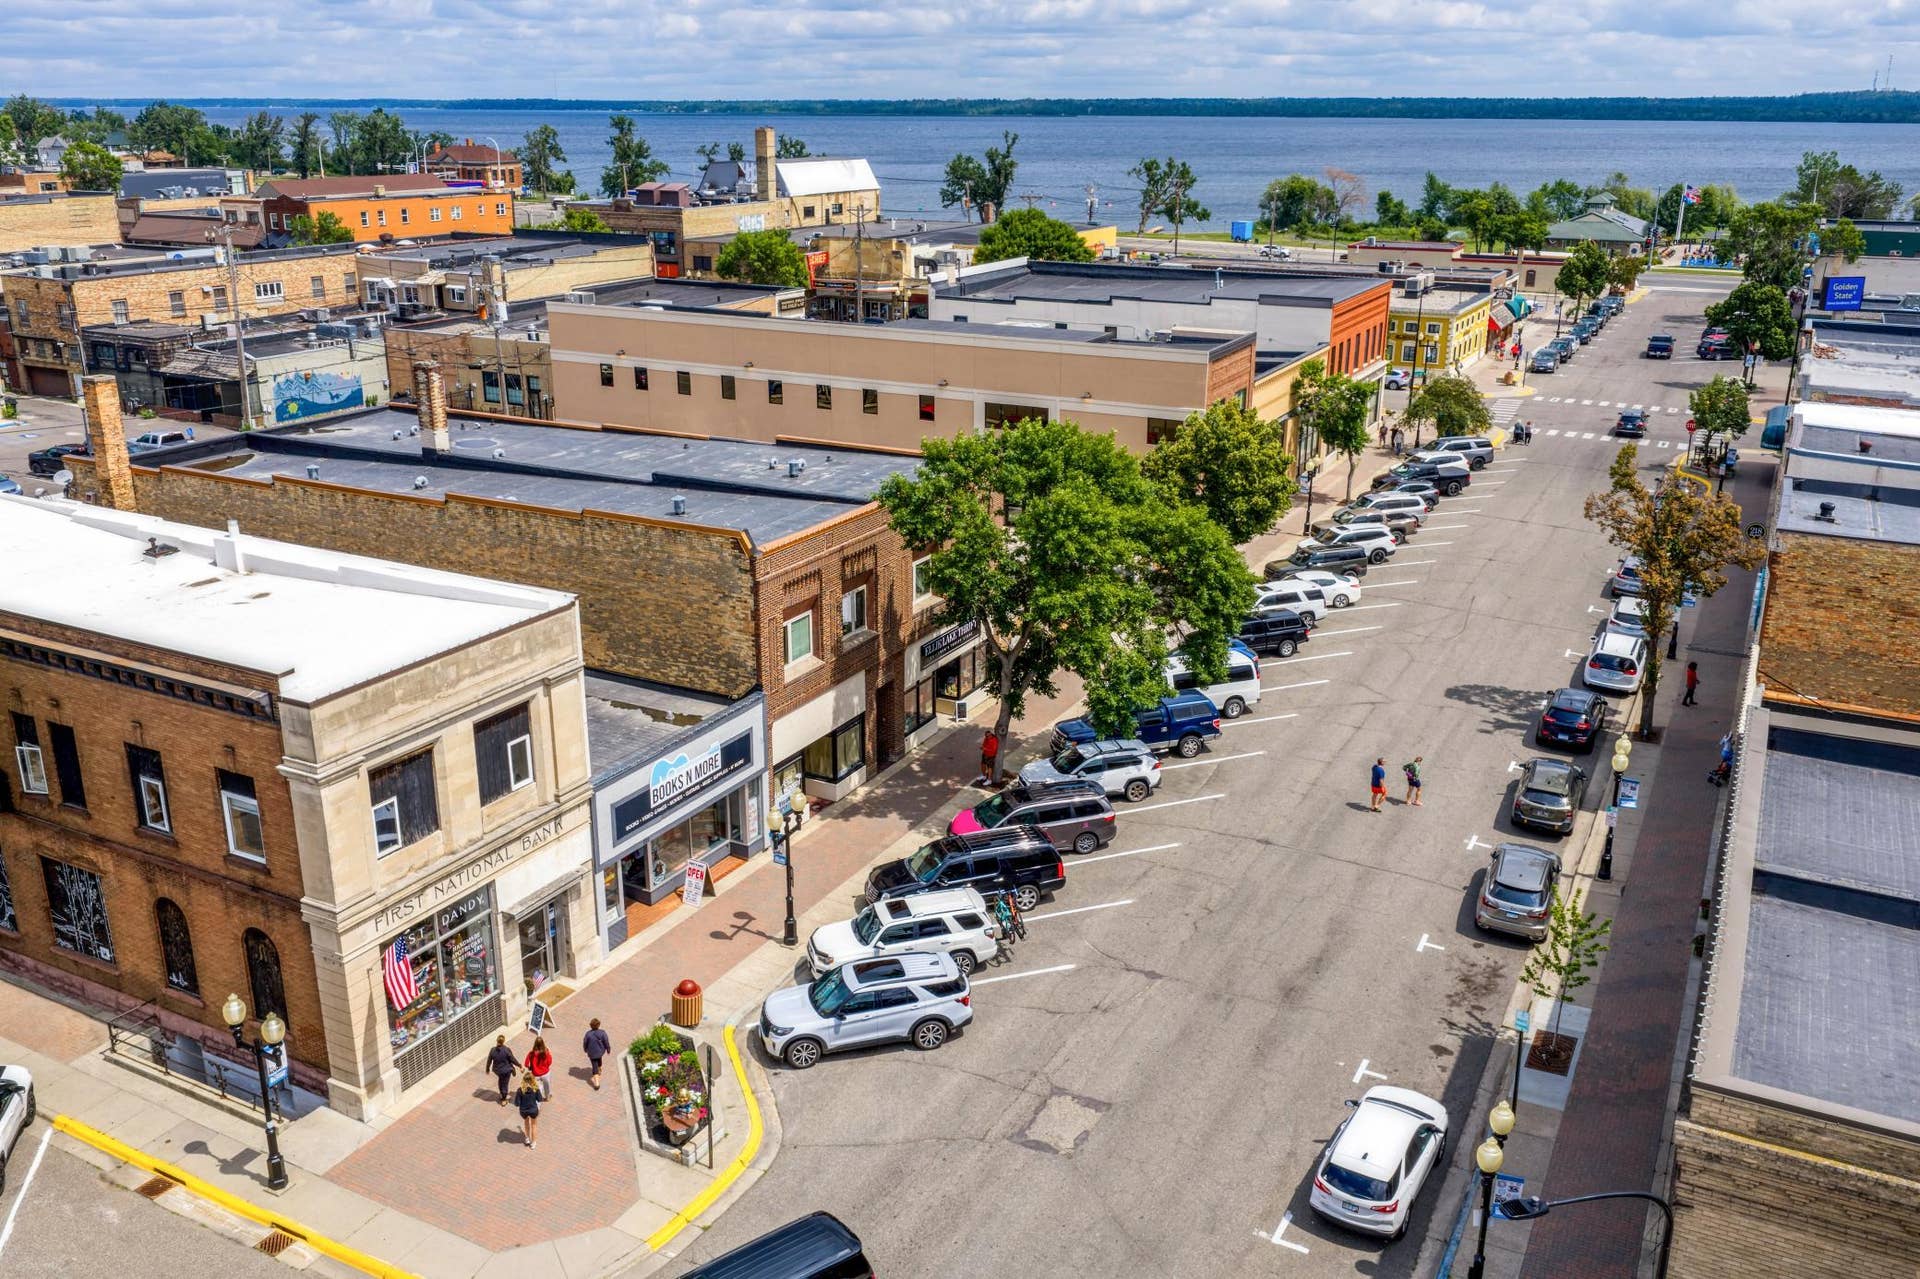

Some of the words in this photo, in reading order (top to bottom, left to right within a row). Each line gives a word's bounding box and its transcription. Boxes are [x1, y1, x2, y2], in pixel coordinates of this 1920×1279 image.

[652, 774, 684, 805] BOOKS
[686, 770, 692, 785] N
[694, 753, 720, 779] MORE
[374, 893, 425, 932] FIRST
[434, 848, 514, 899] NATIONAL
[520, 816, 564, 851] BANK
[688, 867, 704, 880] OPEN
